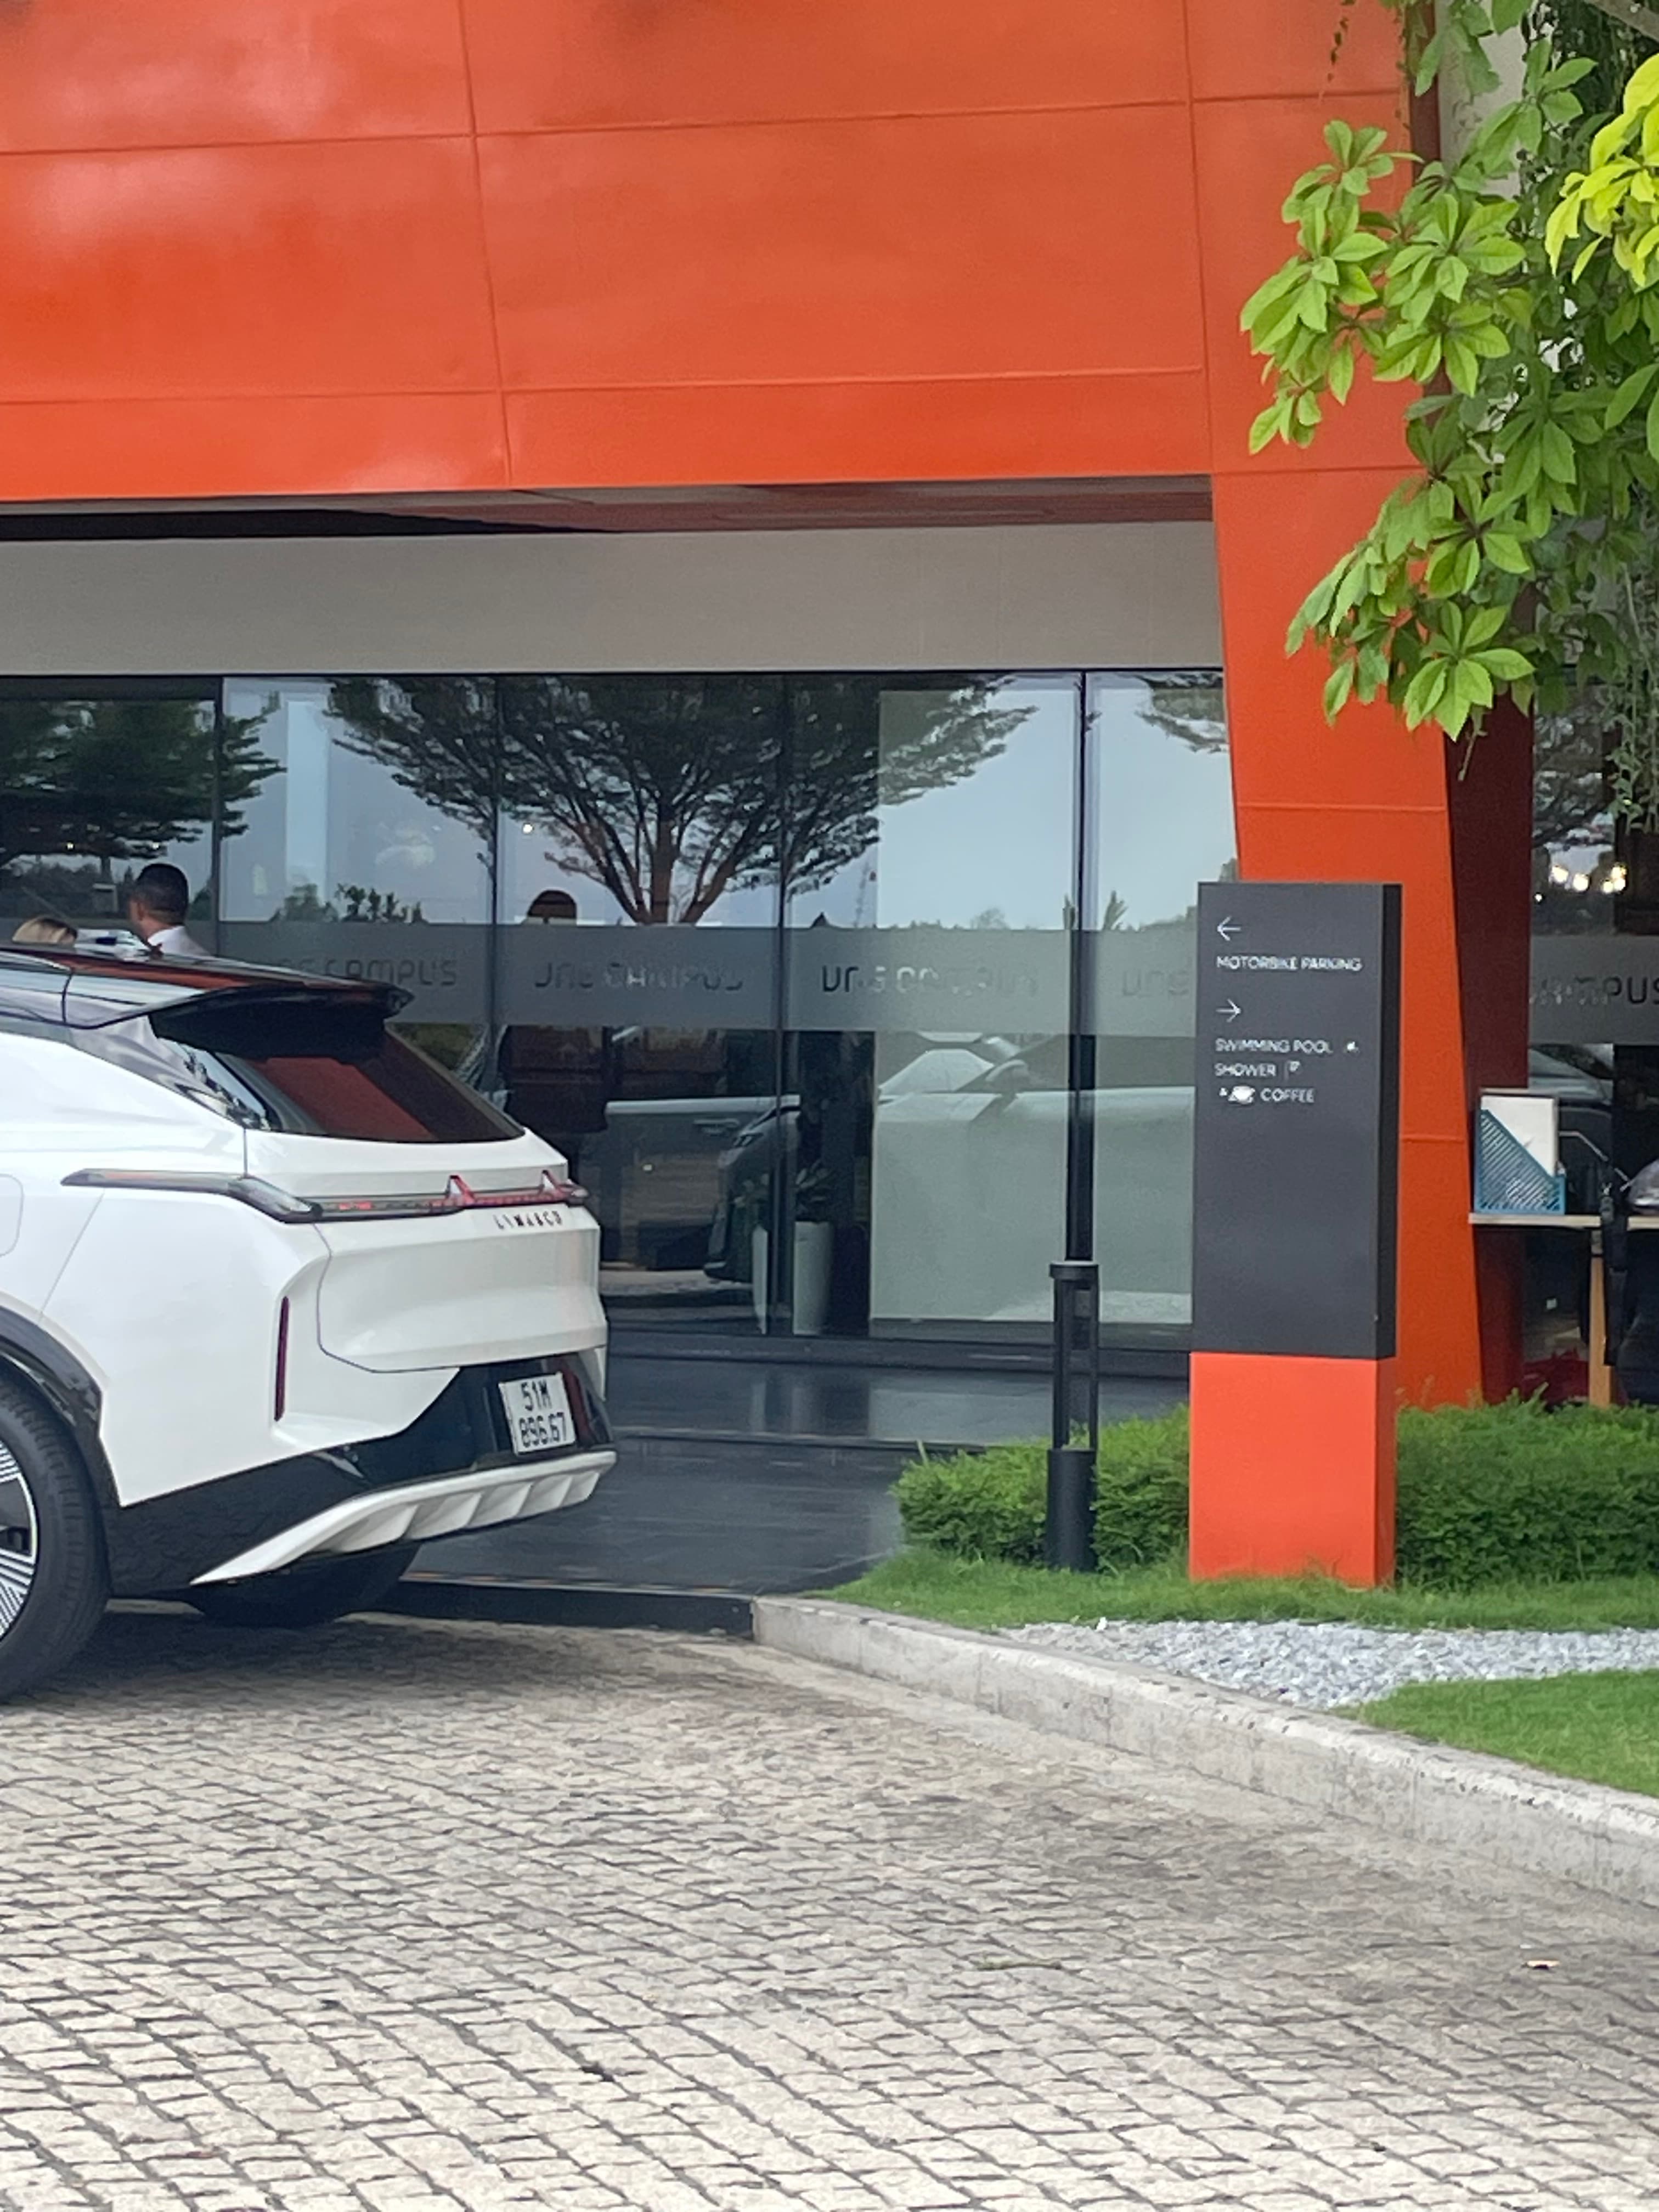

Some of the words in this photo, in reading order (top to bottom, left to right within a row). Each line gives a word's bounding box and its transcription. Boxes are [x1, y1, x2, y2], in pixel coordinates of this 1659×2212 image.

[1216, 956, 1298, 970] MOTORBIKE
[1301, 957, 1363, 972] PARKING
[1215, 1038, 1290, 1053] SWIMMING
[1293, 1039, 1334, 1054] POOL
[1214, 1063, 1277, 1077] SHOWER
[1260, 1088, 1315, 1103] COFFEE
